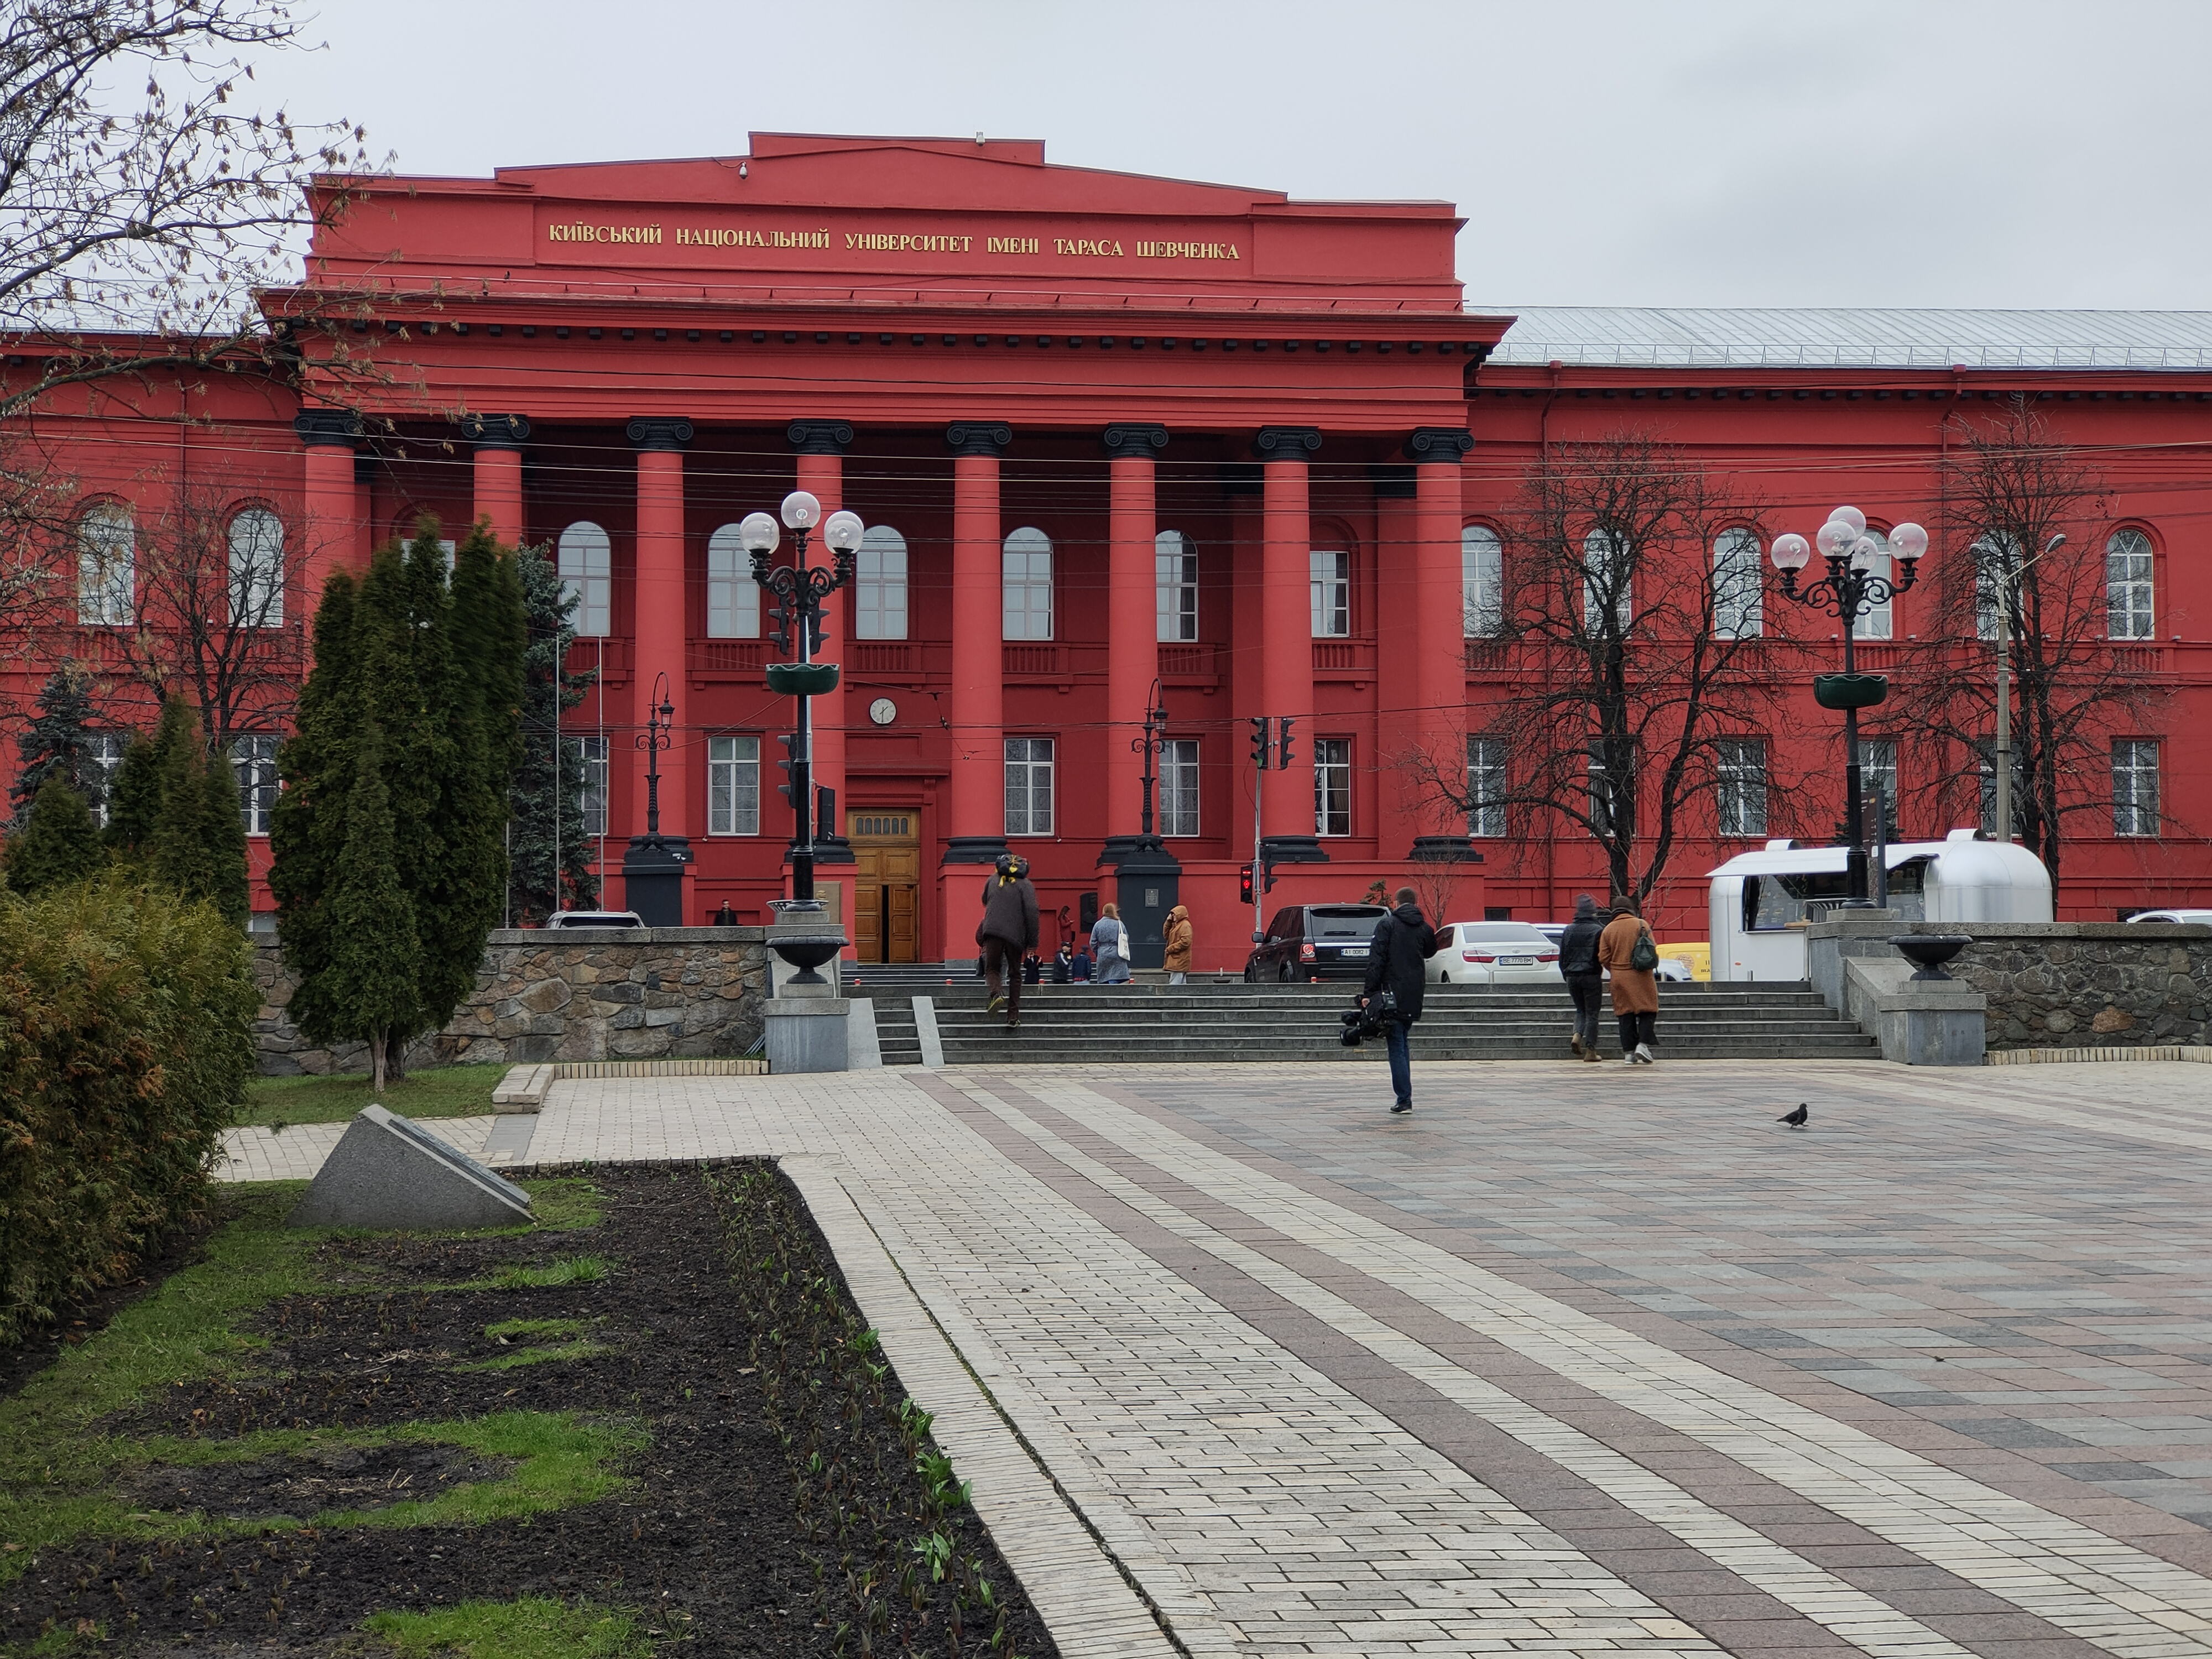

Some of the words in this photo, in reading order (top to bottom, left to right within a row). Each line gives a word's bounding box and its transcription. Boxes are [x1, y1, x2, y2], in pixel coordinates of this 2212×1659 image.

[549, 221, 662, 244] КИЇВСЬКИЙ
[676, 228, 830, 248] НАЦІОНАЛЬНИЙ
[844, 233, 973, 252] УНІВЕРСИТЕТ
[987, 237, 1039, 253] ІМЕНІ
[1053, 238, 1124, 256] ТАРАСА
[1136, 241, 1240, 259] ШЕВЧЕНКА
